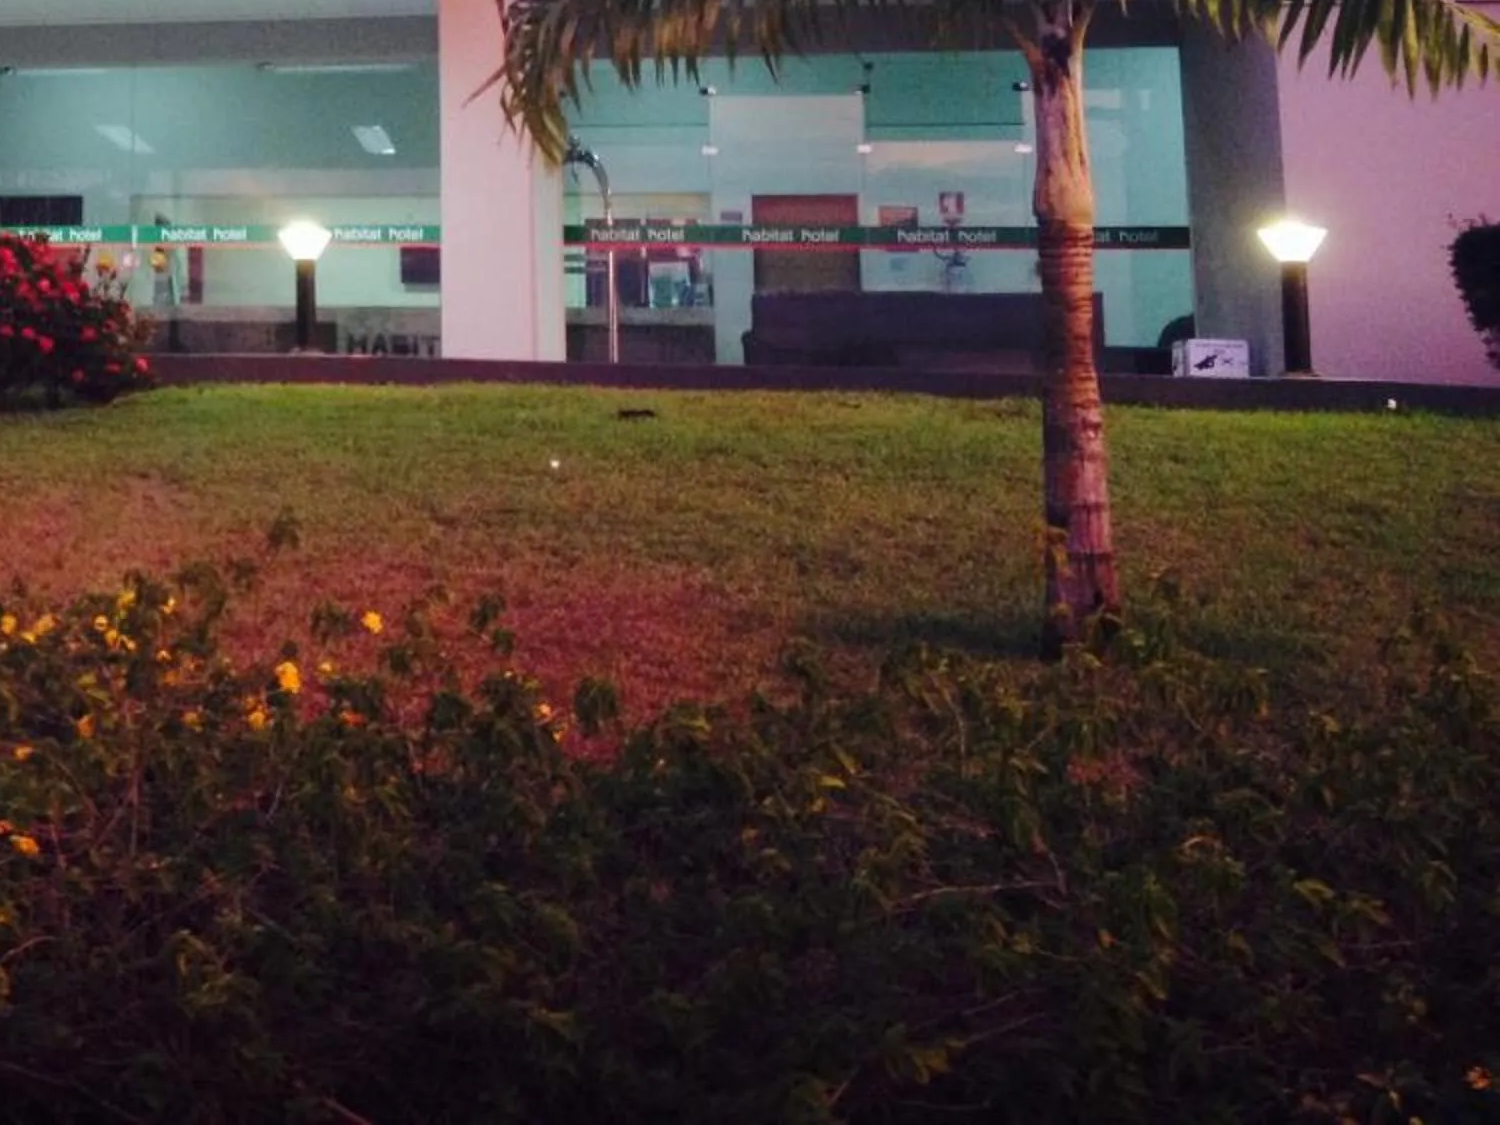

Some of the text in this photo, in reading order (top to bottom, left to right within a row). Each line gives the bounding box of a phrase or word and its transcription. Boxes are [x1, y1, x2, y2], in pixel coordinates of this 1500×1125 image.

[161, 226, 247, 242] habitat hotel
[334, 227, 423, 241] habitat hotel
[591, 227, 685, 242] habitat hotel
[742, 227, 840, 242] habitat hotel
[897, 229, 997, 243] habitat hotel
